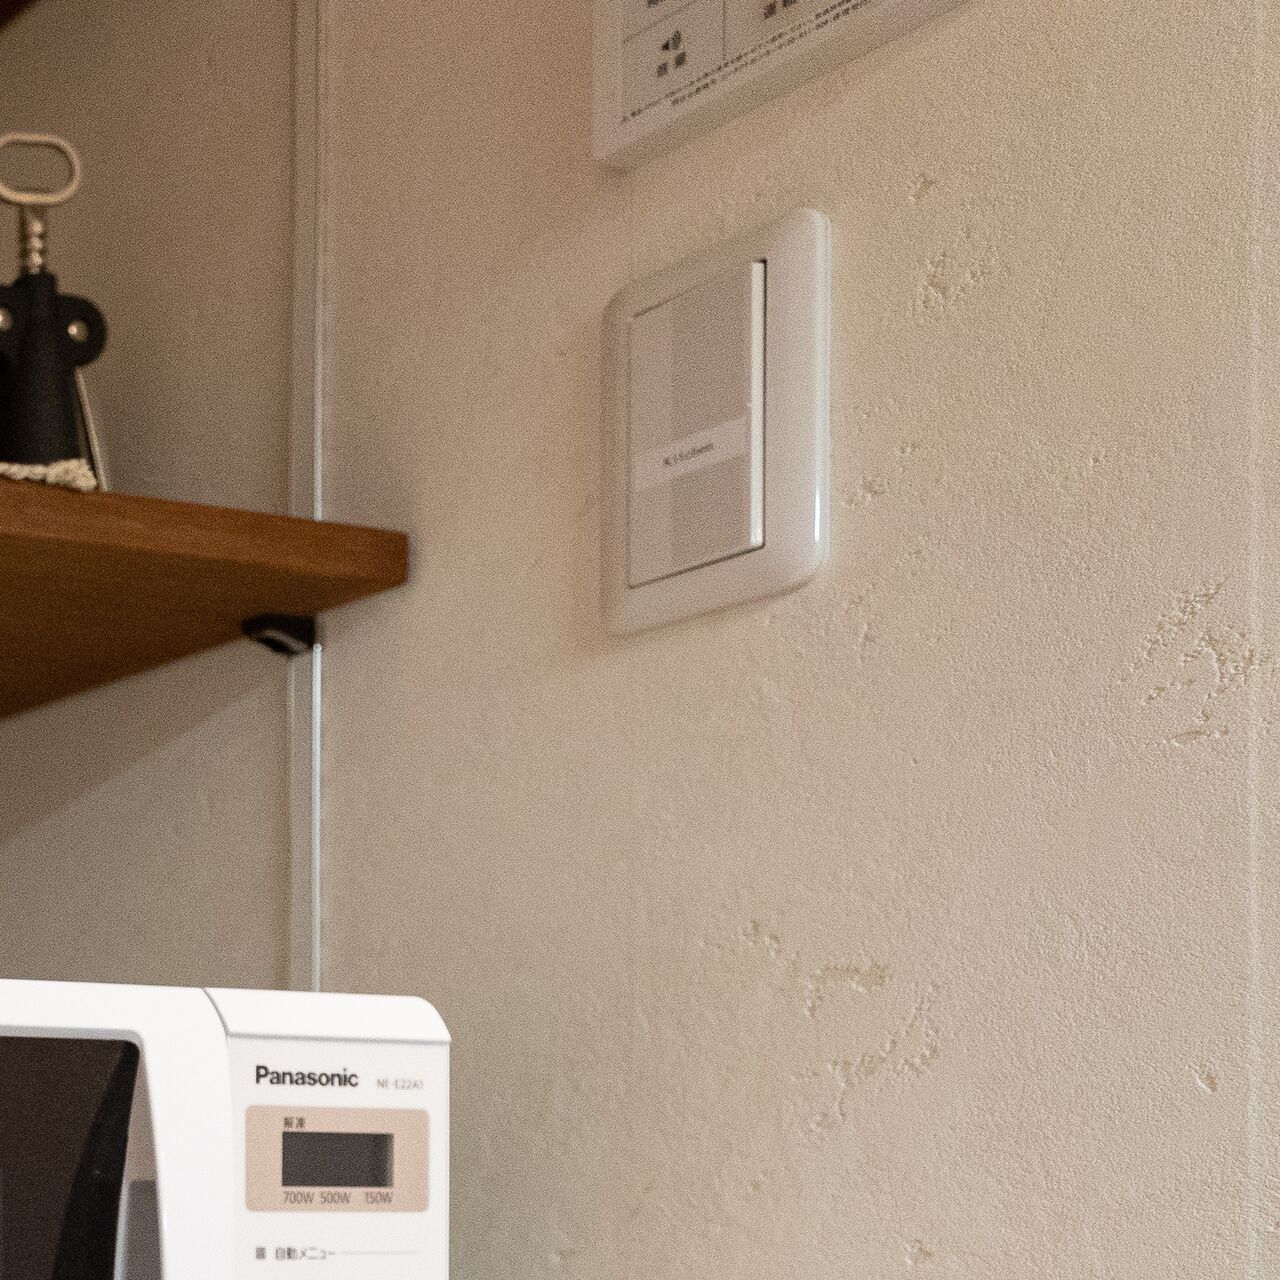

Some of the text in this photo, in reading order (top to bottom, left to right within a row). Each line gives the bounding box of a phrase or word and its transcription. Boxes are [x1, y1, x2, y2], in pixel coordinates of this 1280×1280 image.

[255, 1065, 359, 1087] Panasonic
[283, 1191, 314, 1204] 700W
[320, 1191, 351, 1204] 500W
